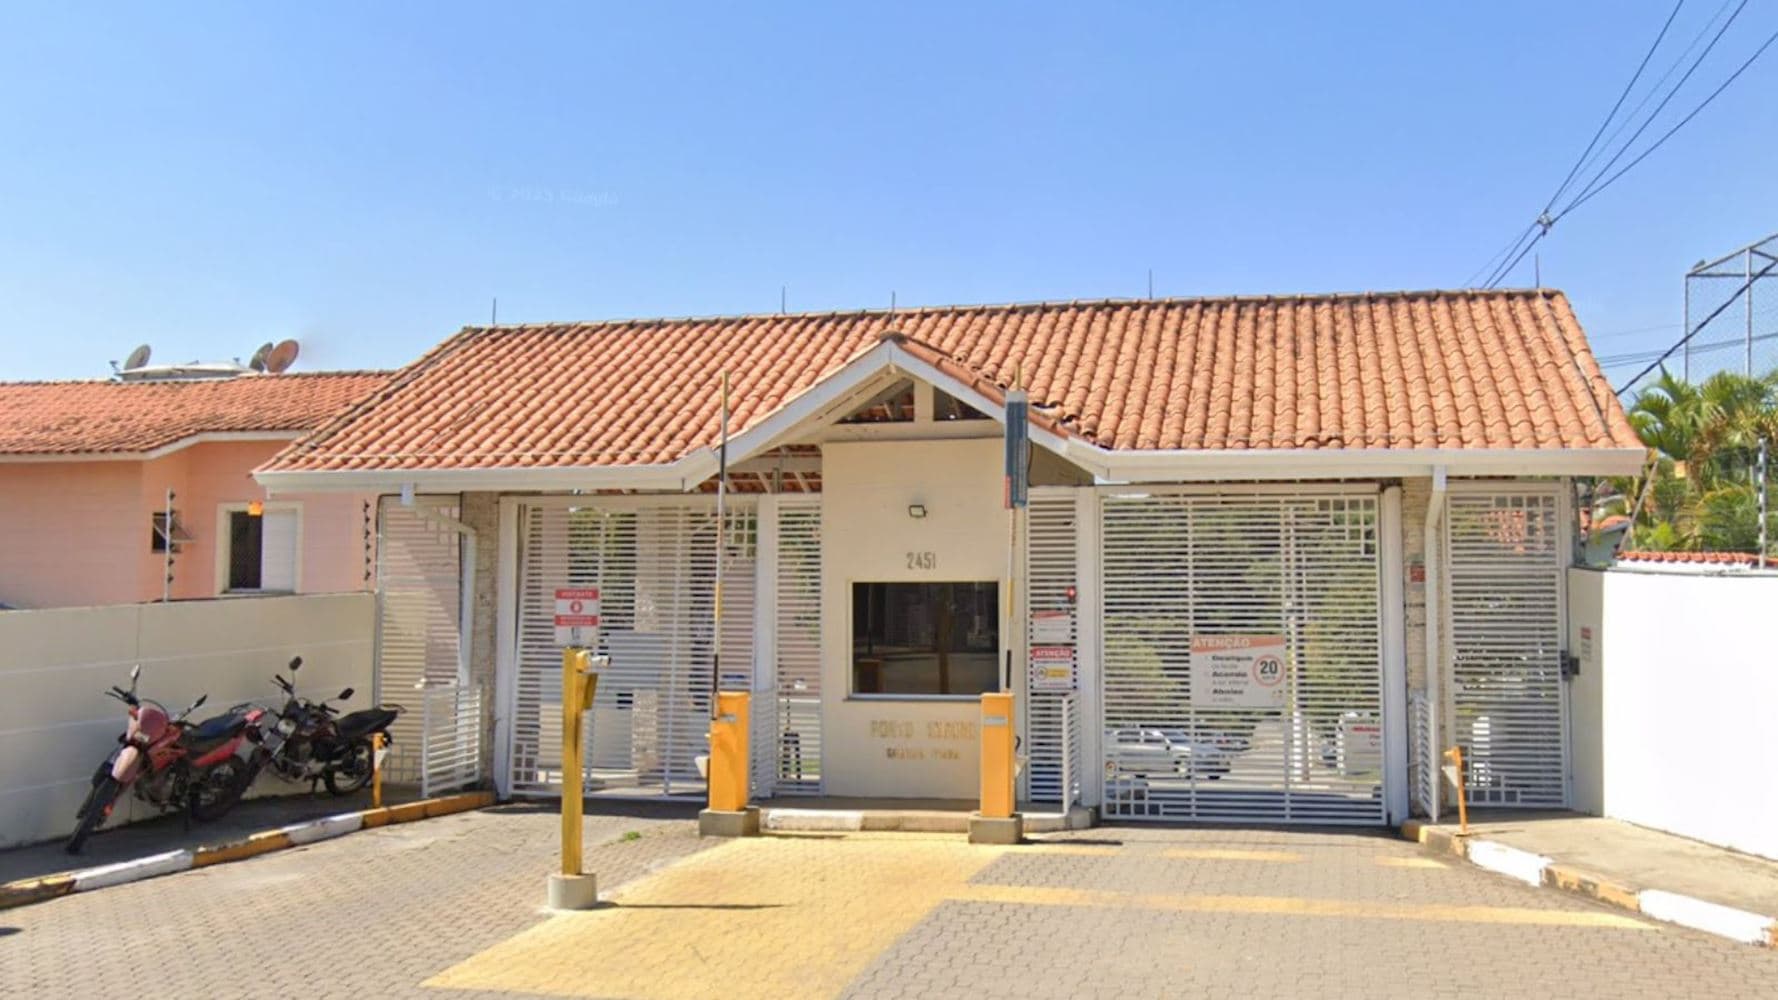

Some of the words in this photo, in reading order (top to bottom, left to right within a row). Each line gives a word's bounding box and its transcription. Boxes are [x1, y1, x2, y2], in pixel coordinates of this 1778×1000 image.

[906, 551, 936, 570] 2451
[1193, 637, 1250, 649] ATENÇÃO
[1260, 660, 1278, 675] 20
